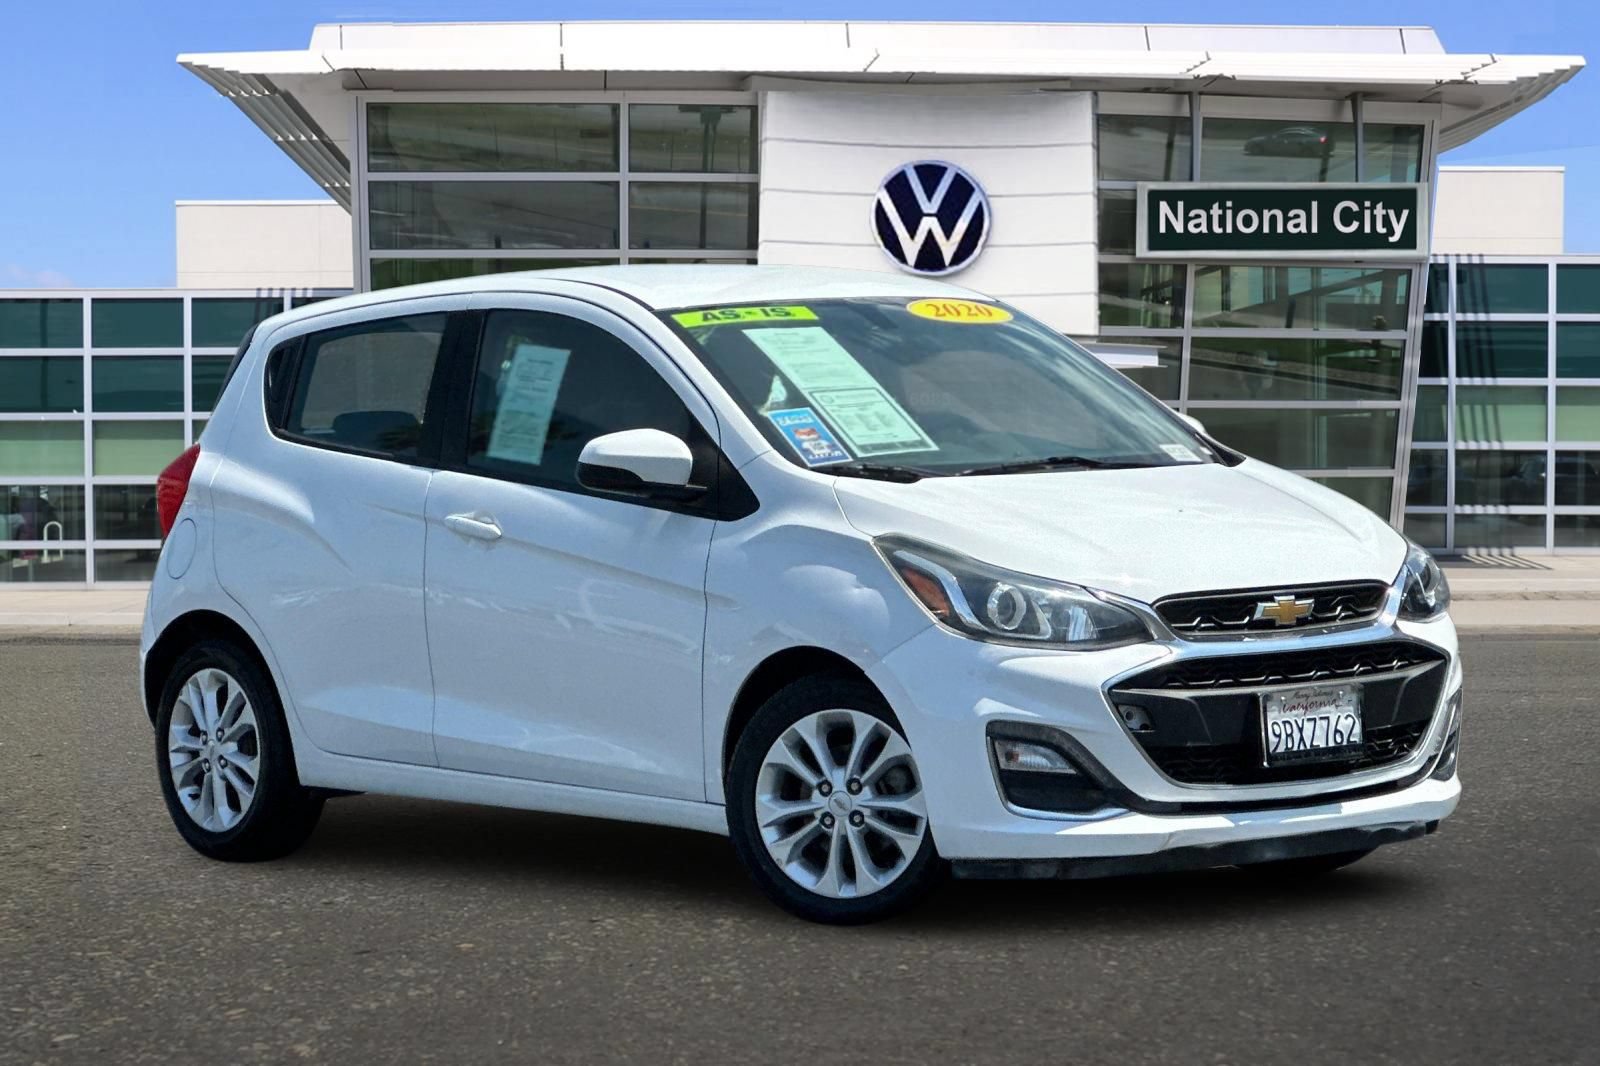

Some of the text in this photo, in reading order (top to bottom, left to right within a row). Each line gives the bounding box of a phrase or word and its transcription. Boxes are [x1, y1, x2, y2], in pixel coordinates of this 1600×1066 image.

[876, 164, 982, 268] VW
[1158, 200, 1410, 243] National City
[925, 303, 993, 318] 2020
[1270, 713, 1359, 754] 9BXZ762
